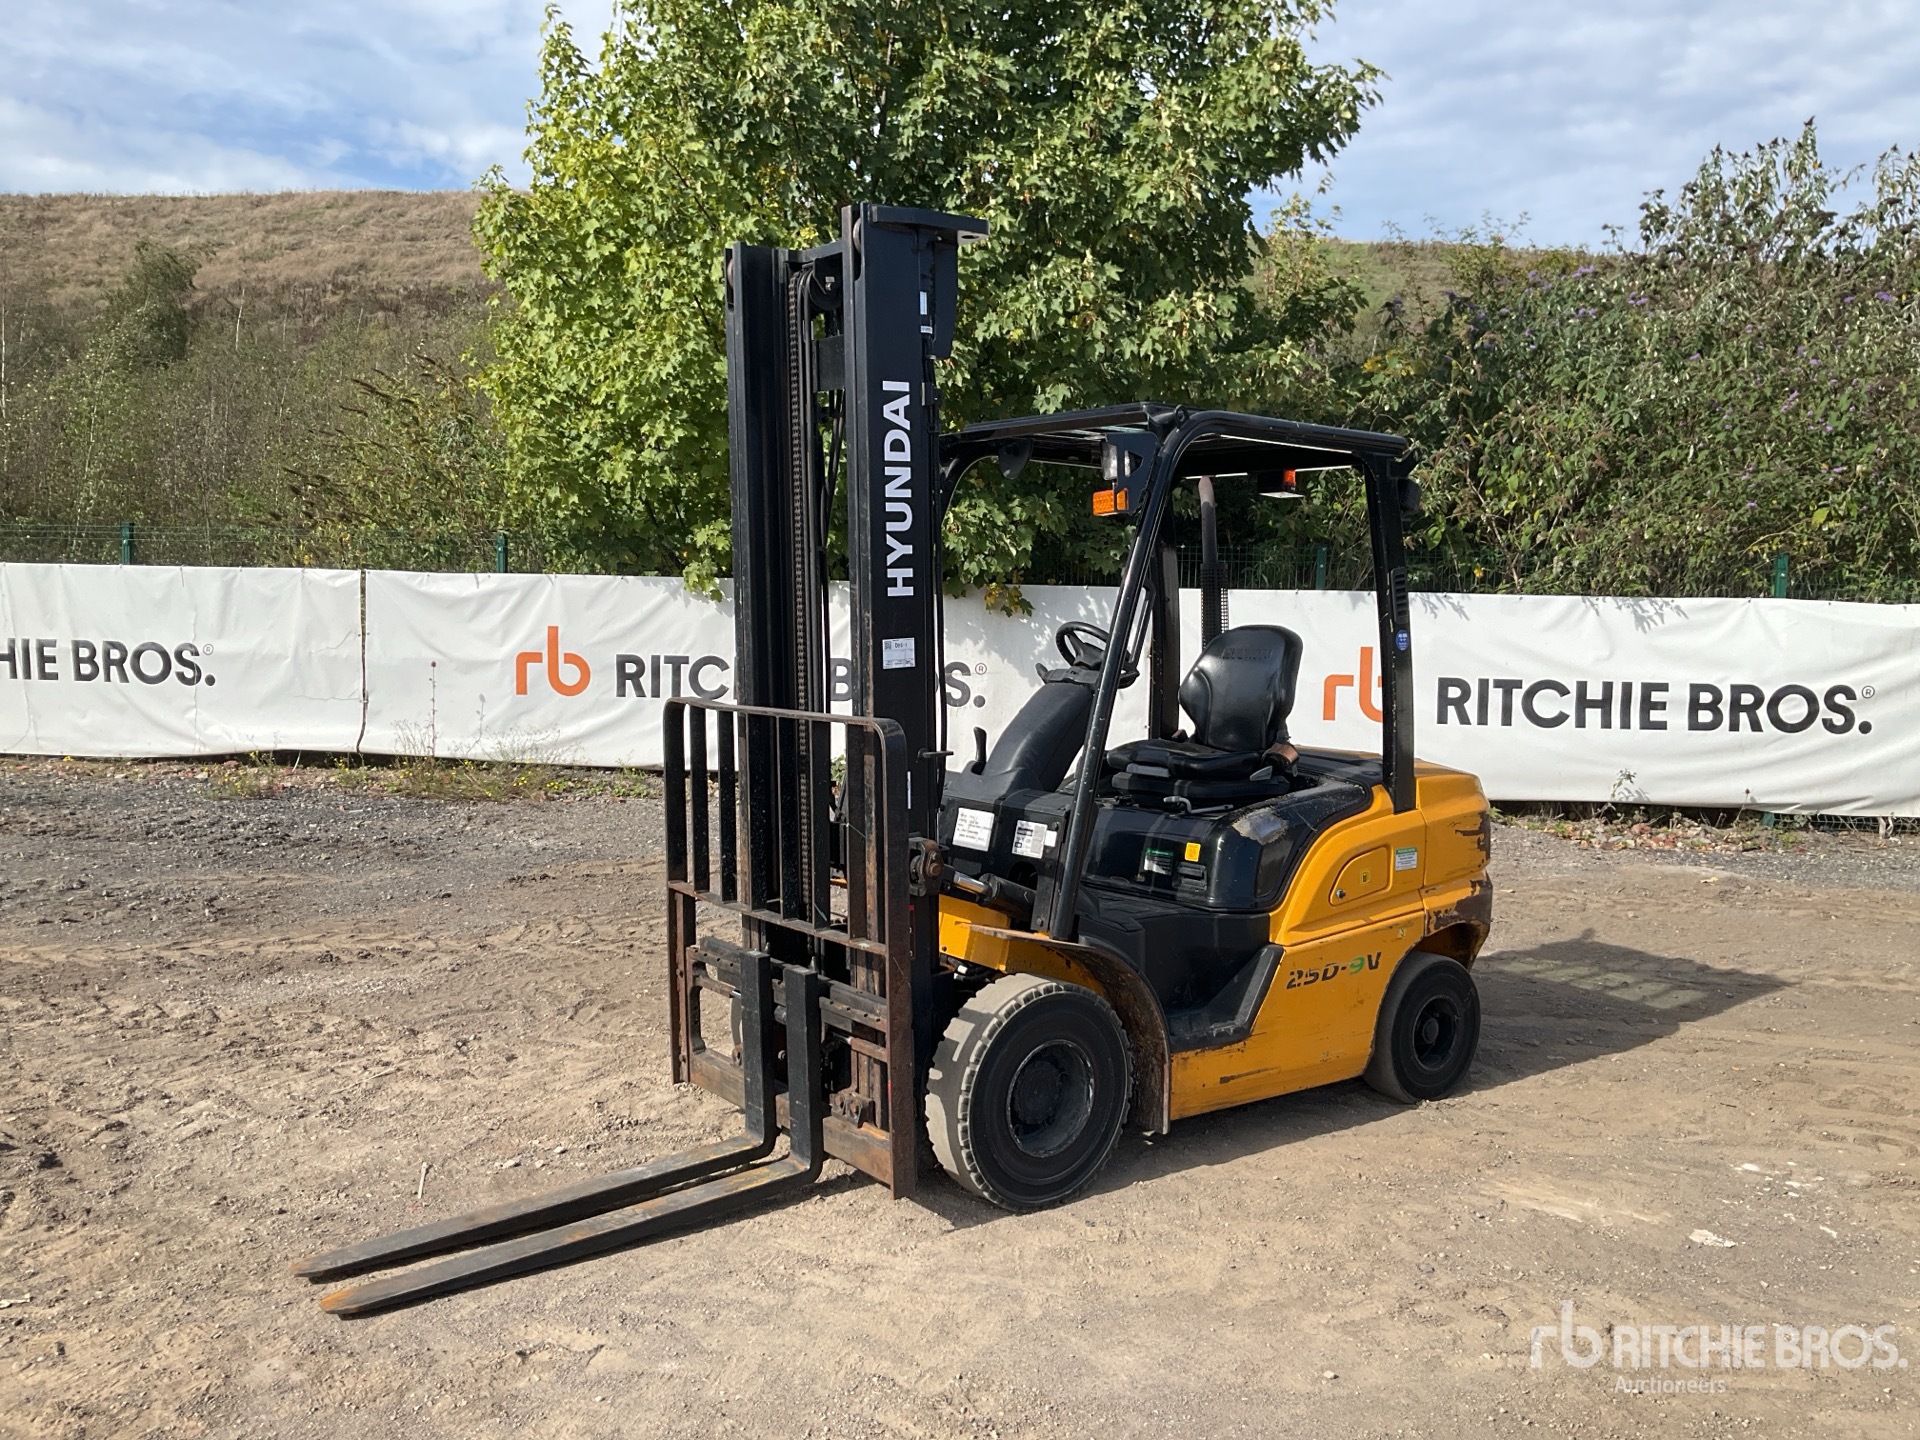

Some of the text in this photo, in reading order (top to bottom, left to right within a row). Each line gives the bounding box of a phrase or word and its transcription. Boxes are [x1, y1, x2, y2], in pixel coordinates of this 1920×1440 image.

[882, 380, 914, 597] HYUNDAI
[71, 639, 216, 687] BROS.
[515, 625, 591, 697] rb
[615, 653, 986, 708] RITC BS.
[1436, 676, 1873, 735] RITCHIE BROS.
[1286, 951, 1382, 990] 25D-9V
